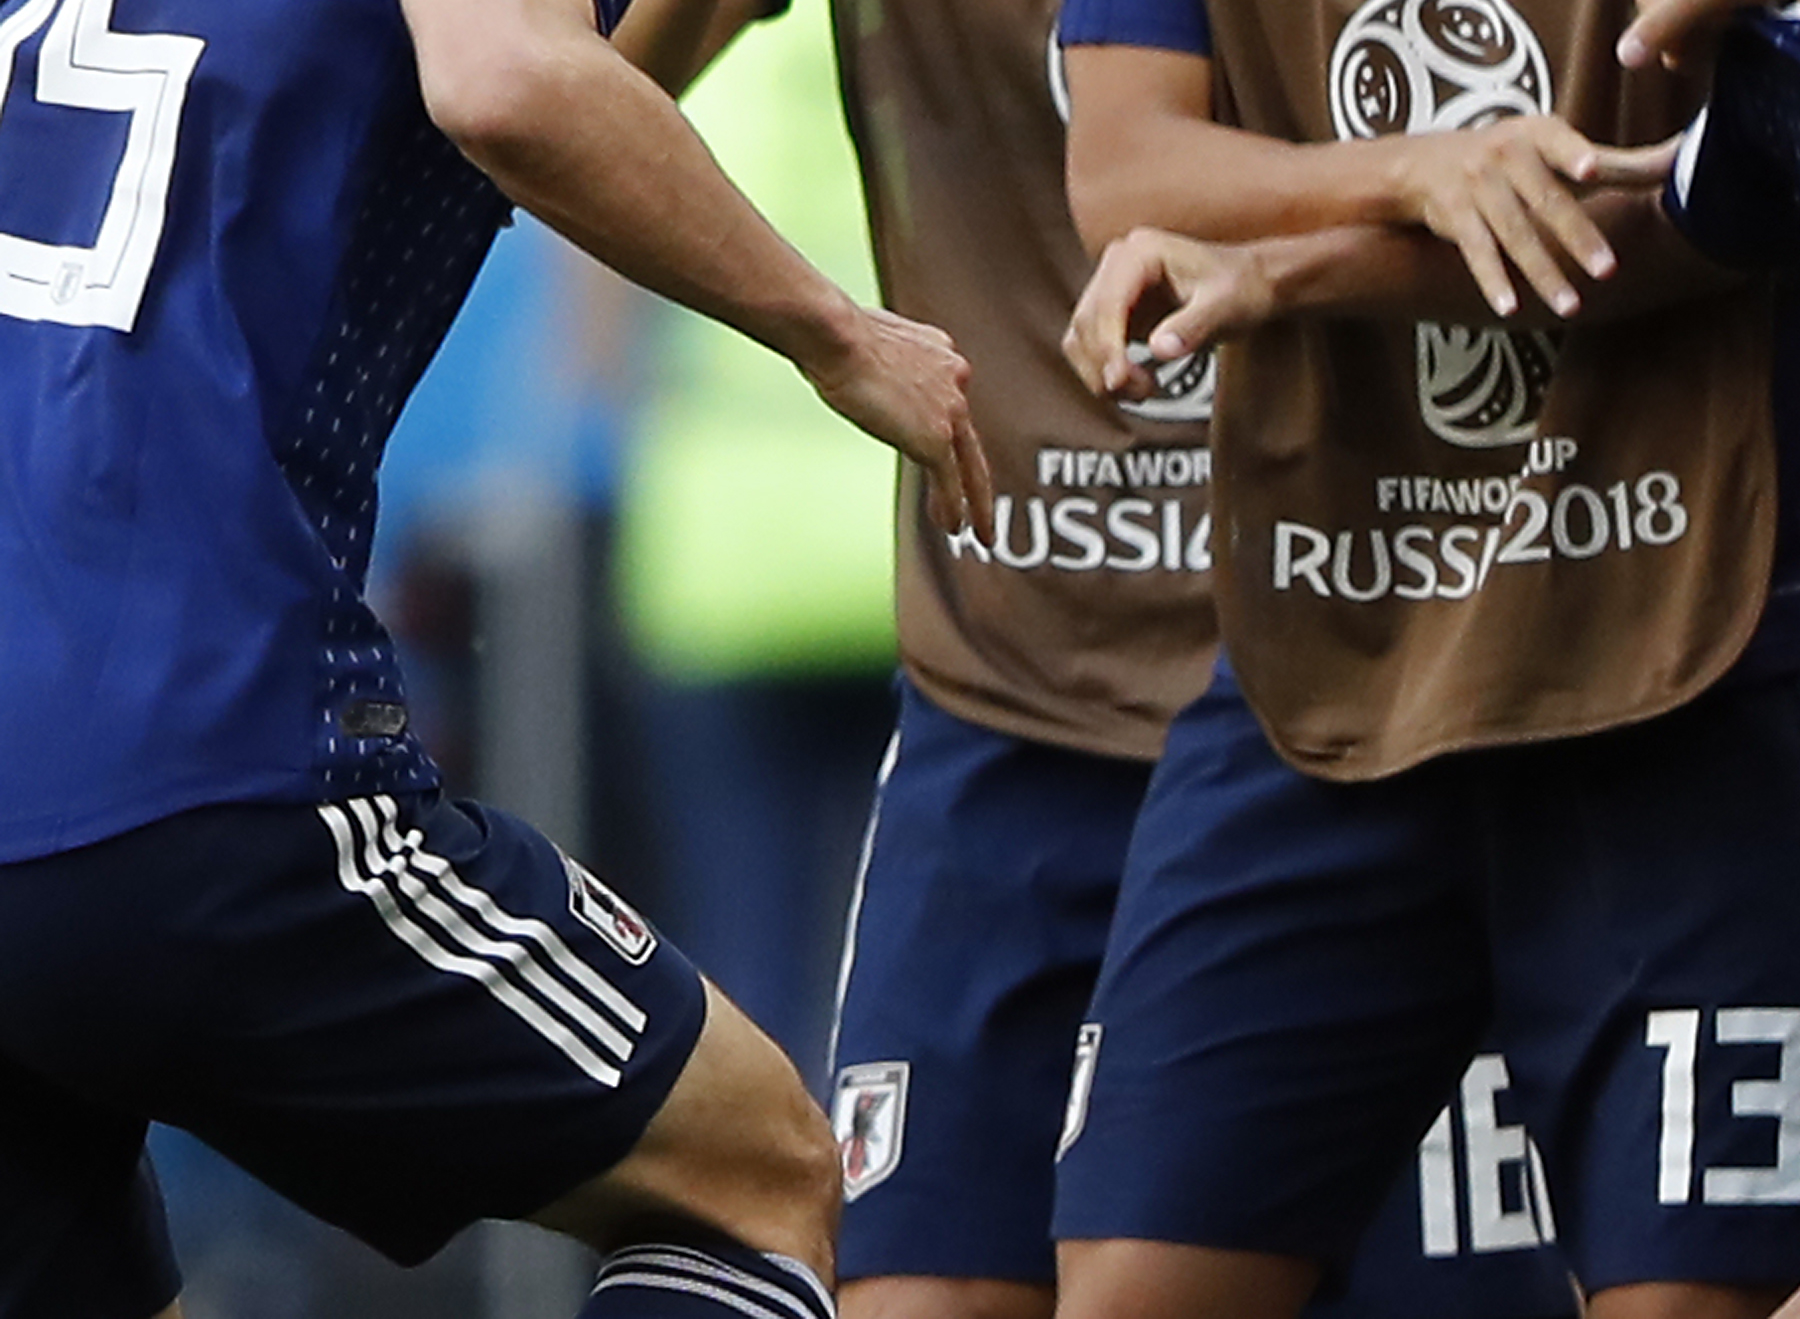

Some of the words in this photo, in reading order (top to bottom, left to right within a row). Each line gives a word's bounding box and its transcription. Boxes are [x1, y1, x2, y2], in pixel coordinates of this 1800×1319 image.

[1038, 448, 1123, 487] FIFA
[1375, 476, 1450, 513] FIFA
[1523, 436, 1579, 478] UP
[1497, 470, 1689, 564] 2018
[1418, 1053, 1557, 1258] 16
